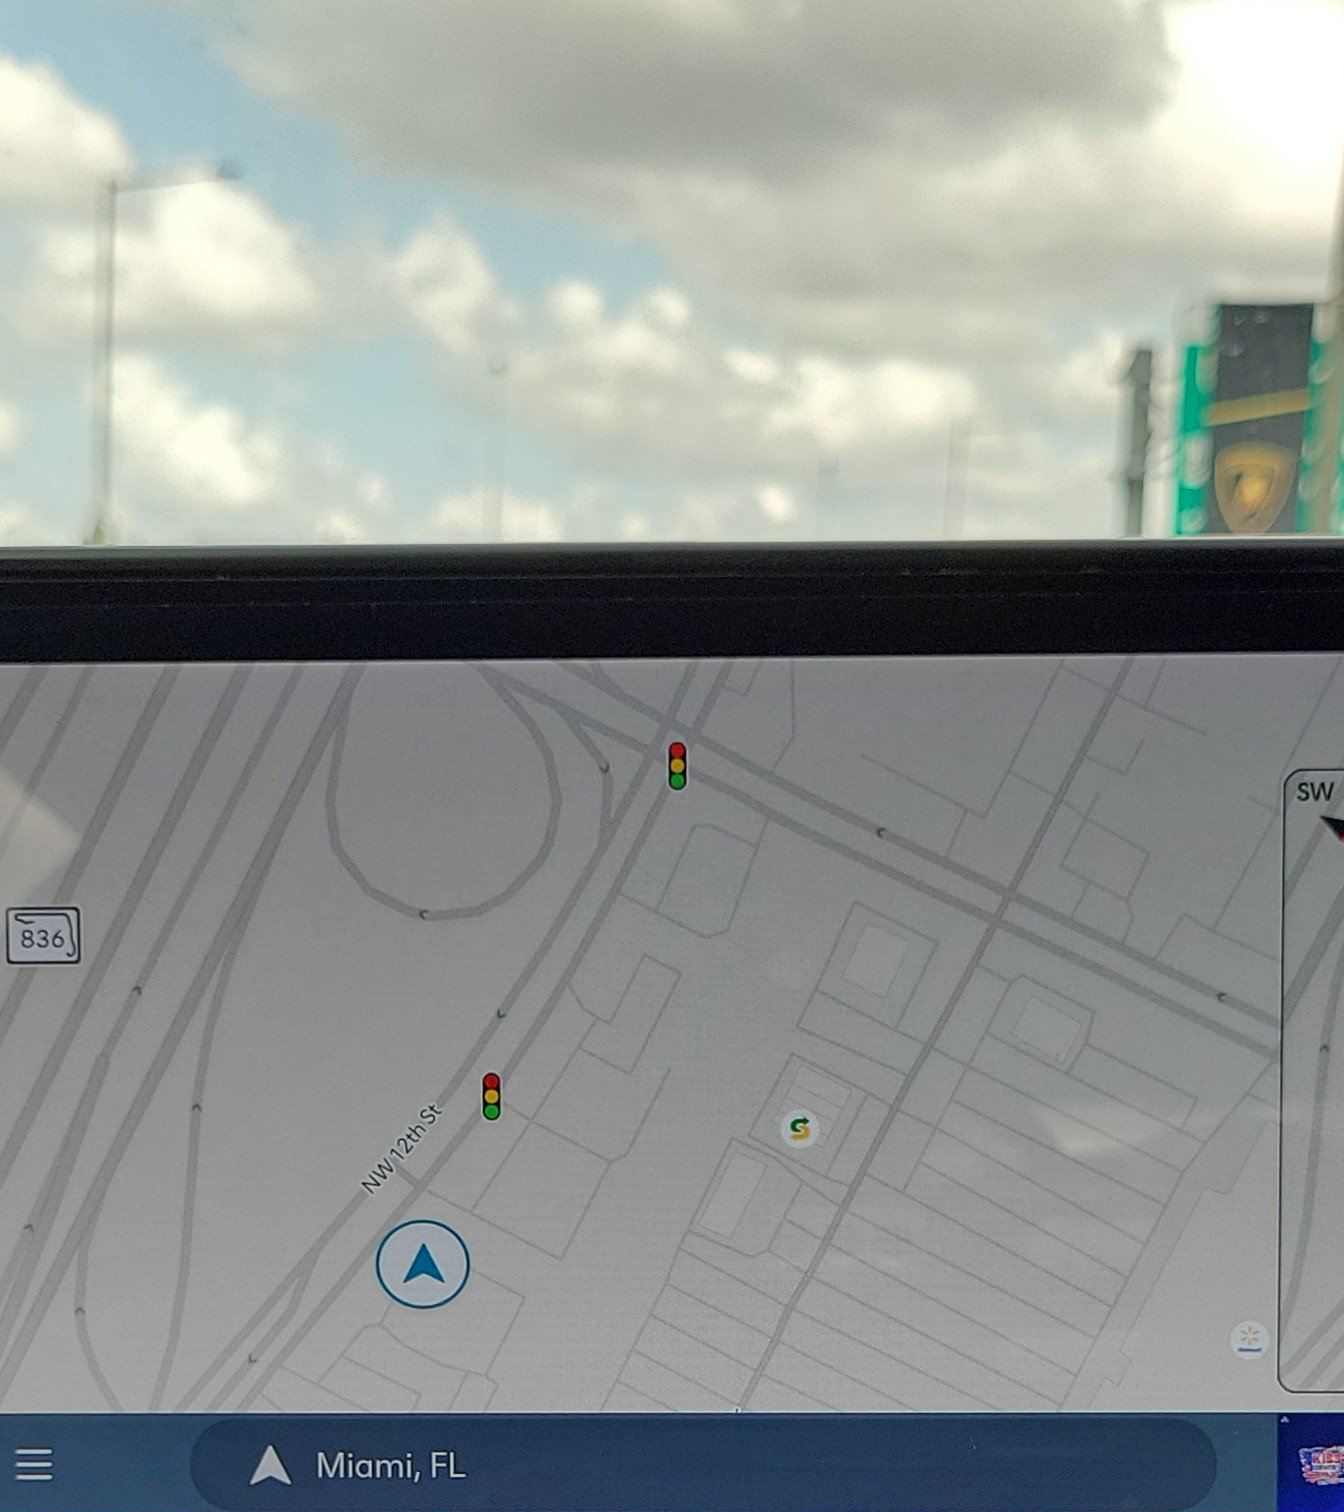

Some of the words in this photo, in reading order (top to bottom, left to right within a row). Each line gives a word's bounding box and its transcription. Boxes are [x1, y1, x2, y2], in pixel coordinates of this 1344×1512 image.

[1297, 781, 1334, 801] SW
[20, 928, 66, 950] 836
[360, 1156, 395, 1195] NW
[387, 1120, 430, 1162] 12th
[418, 1102, 444, 1126] St
[316, 1452, 421, 1484] Miami,
[430, 1453, 467, 1479] FL
